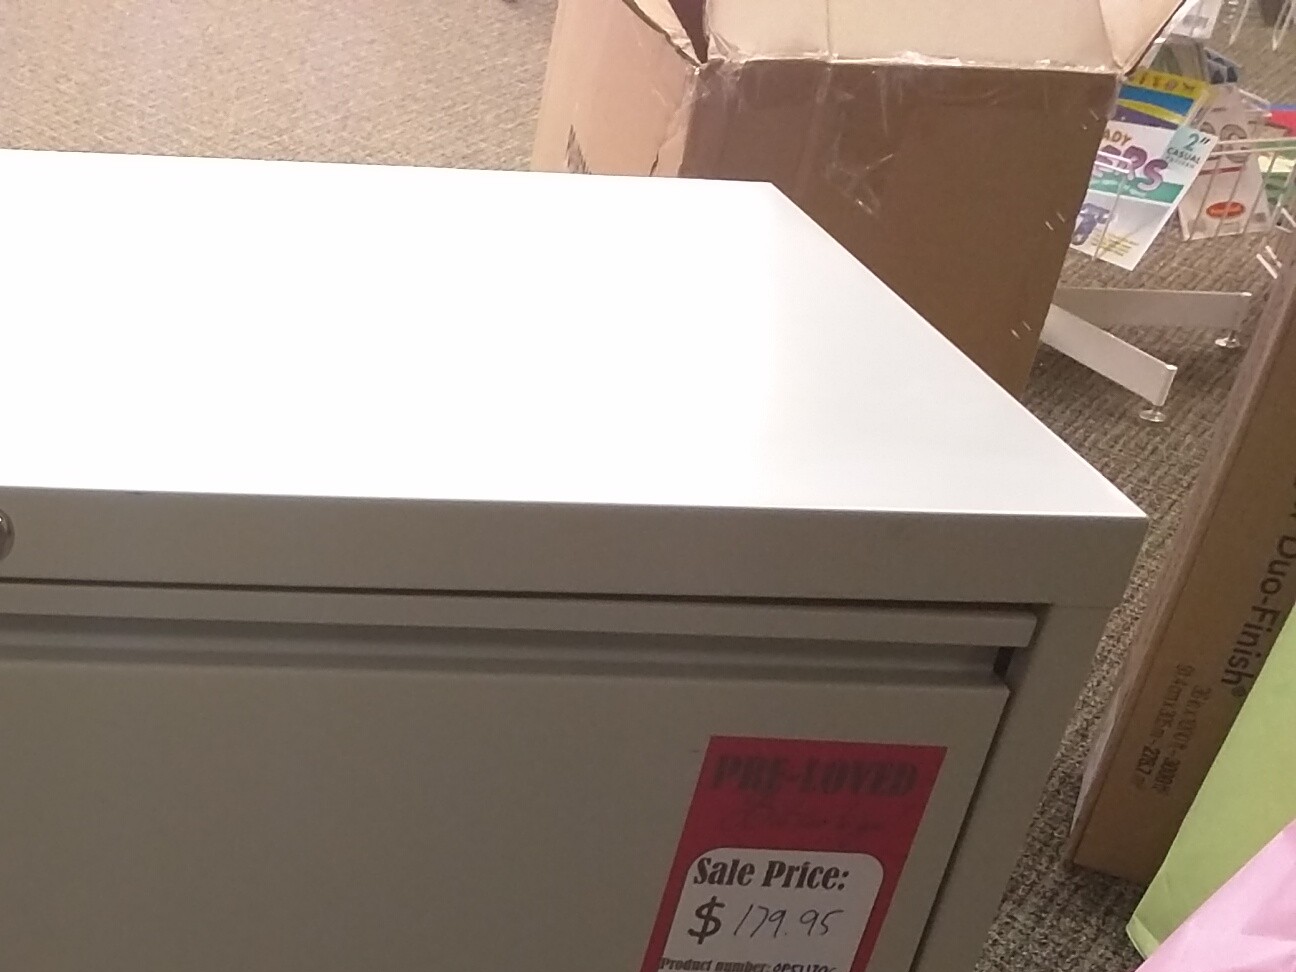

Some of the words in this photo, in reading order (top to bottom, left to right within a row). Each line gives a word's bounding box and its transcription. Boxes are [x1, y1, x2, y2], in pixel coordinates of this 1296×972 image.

[692, 857, 755, 888] Sale
[761, 859, 850, 892] Price:
[687, 896, 726, 945] $
[733, 904, 844, 939] 179.95
